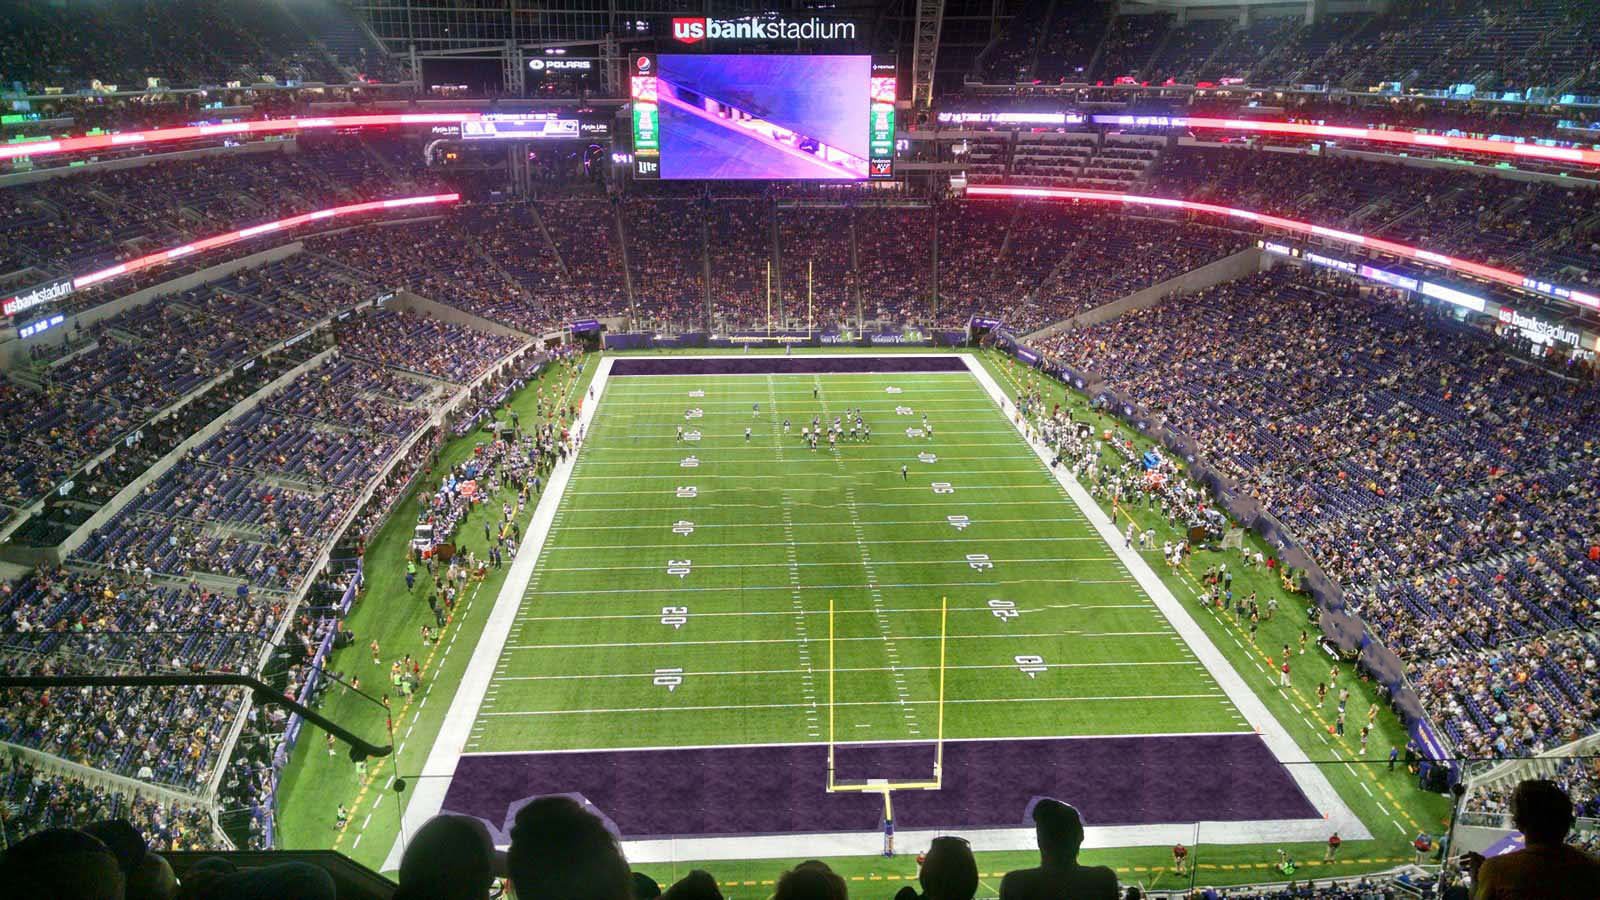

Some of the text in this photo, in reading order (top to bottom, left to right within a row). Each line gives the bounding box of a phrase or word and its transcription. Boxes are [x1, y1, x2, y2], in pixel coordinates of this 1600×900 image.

[546, 61, 591, 69] POLARIS
[638, 160, 657, 173] Lite
[667, 559, 691, 575] 30
[965, 554, 994, 569] 30
[661, 607, 688, 625] 20
[987, 600, 1020, 617] 20
[1014, 655, 1049, 673] 10
[652, 668, 683, 685] 10
